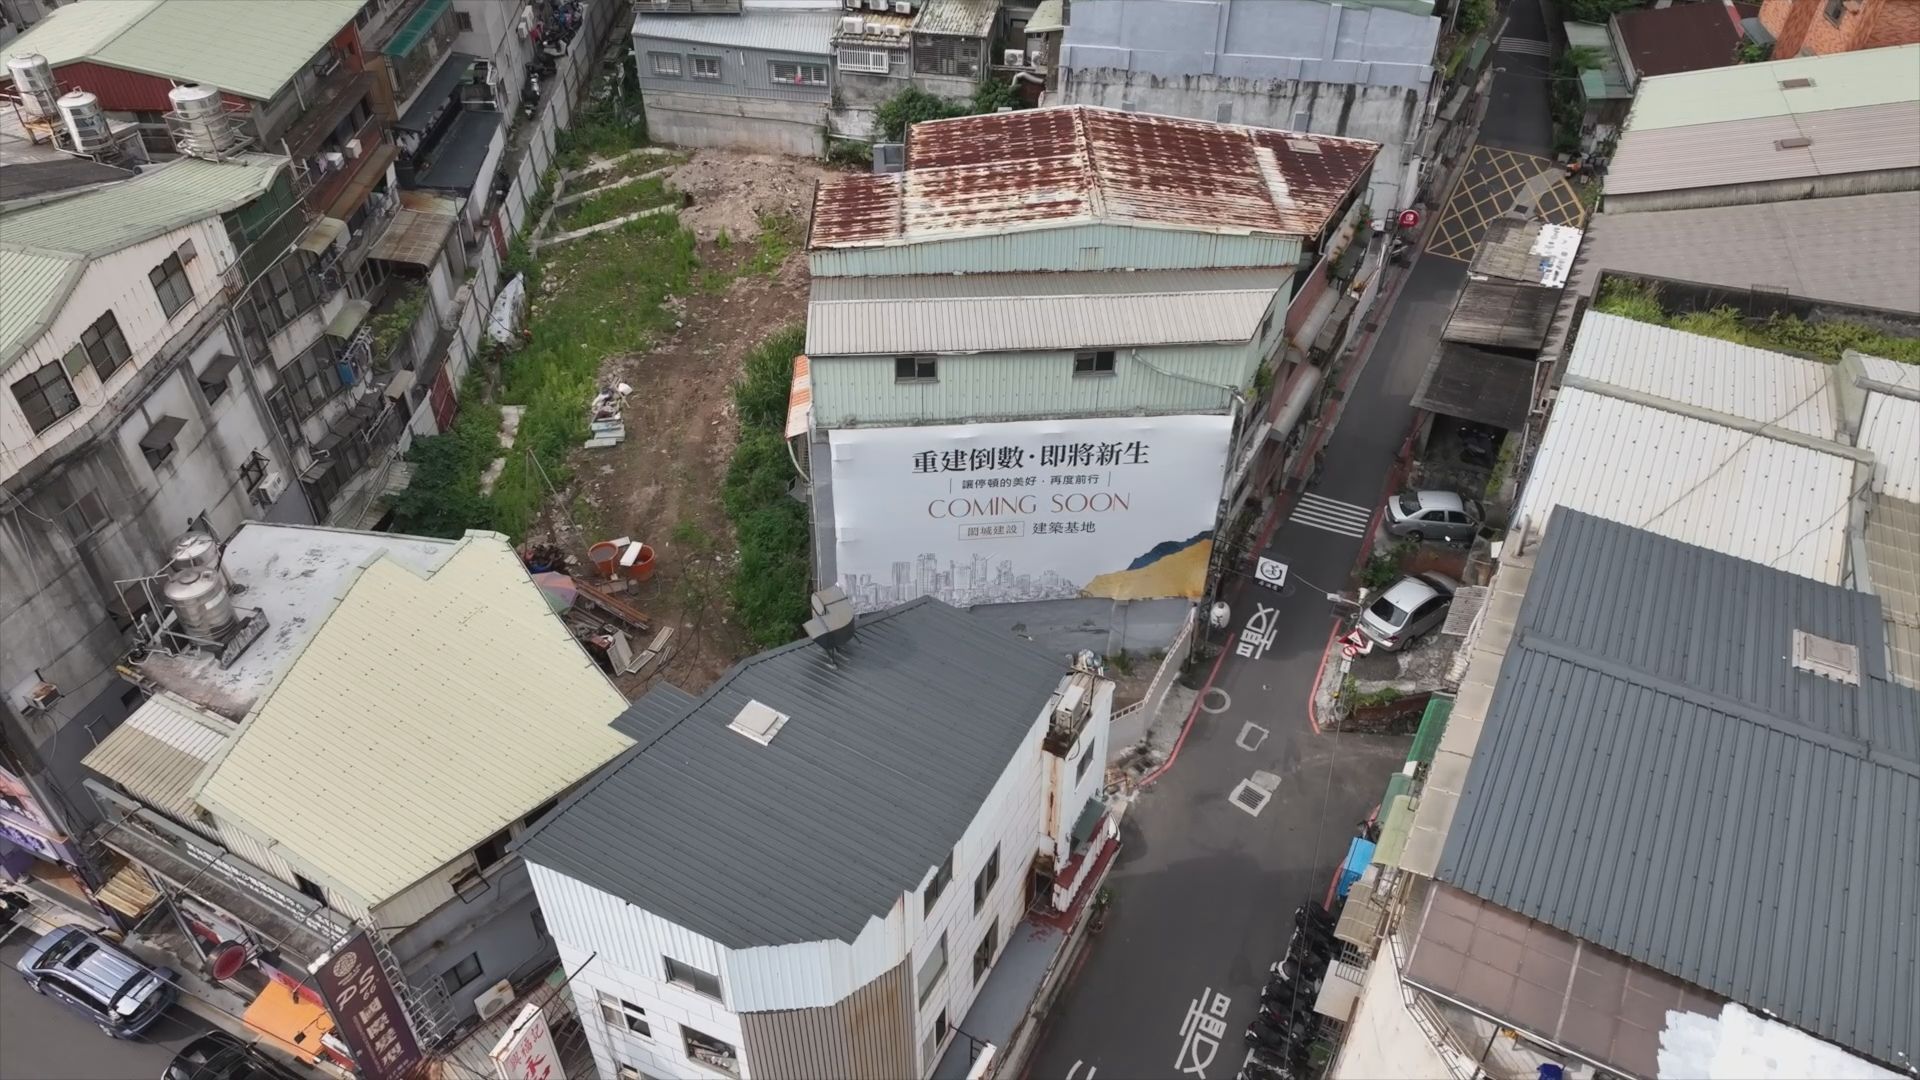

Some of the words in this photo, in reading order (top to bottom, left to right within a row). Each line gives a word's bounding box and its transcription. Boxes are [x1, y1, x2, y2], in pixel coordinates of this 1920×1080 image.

[928, 495, 1037, 519] COMING
[1051, 491, 1130, 514] SOON
[1032, 521, 1096, 535] 建築基地
[1236, 603, 1280, 660] 慢
[1175, 987, 1232, 1080] 慢
